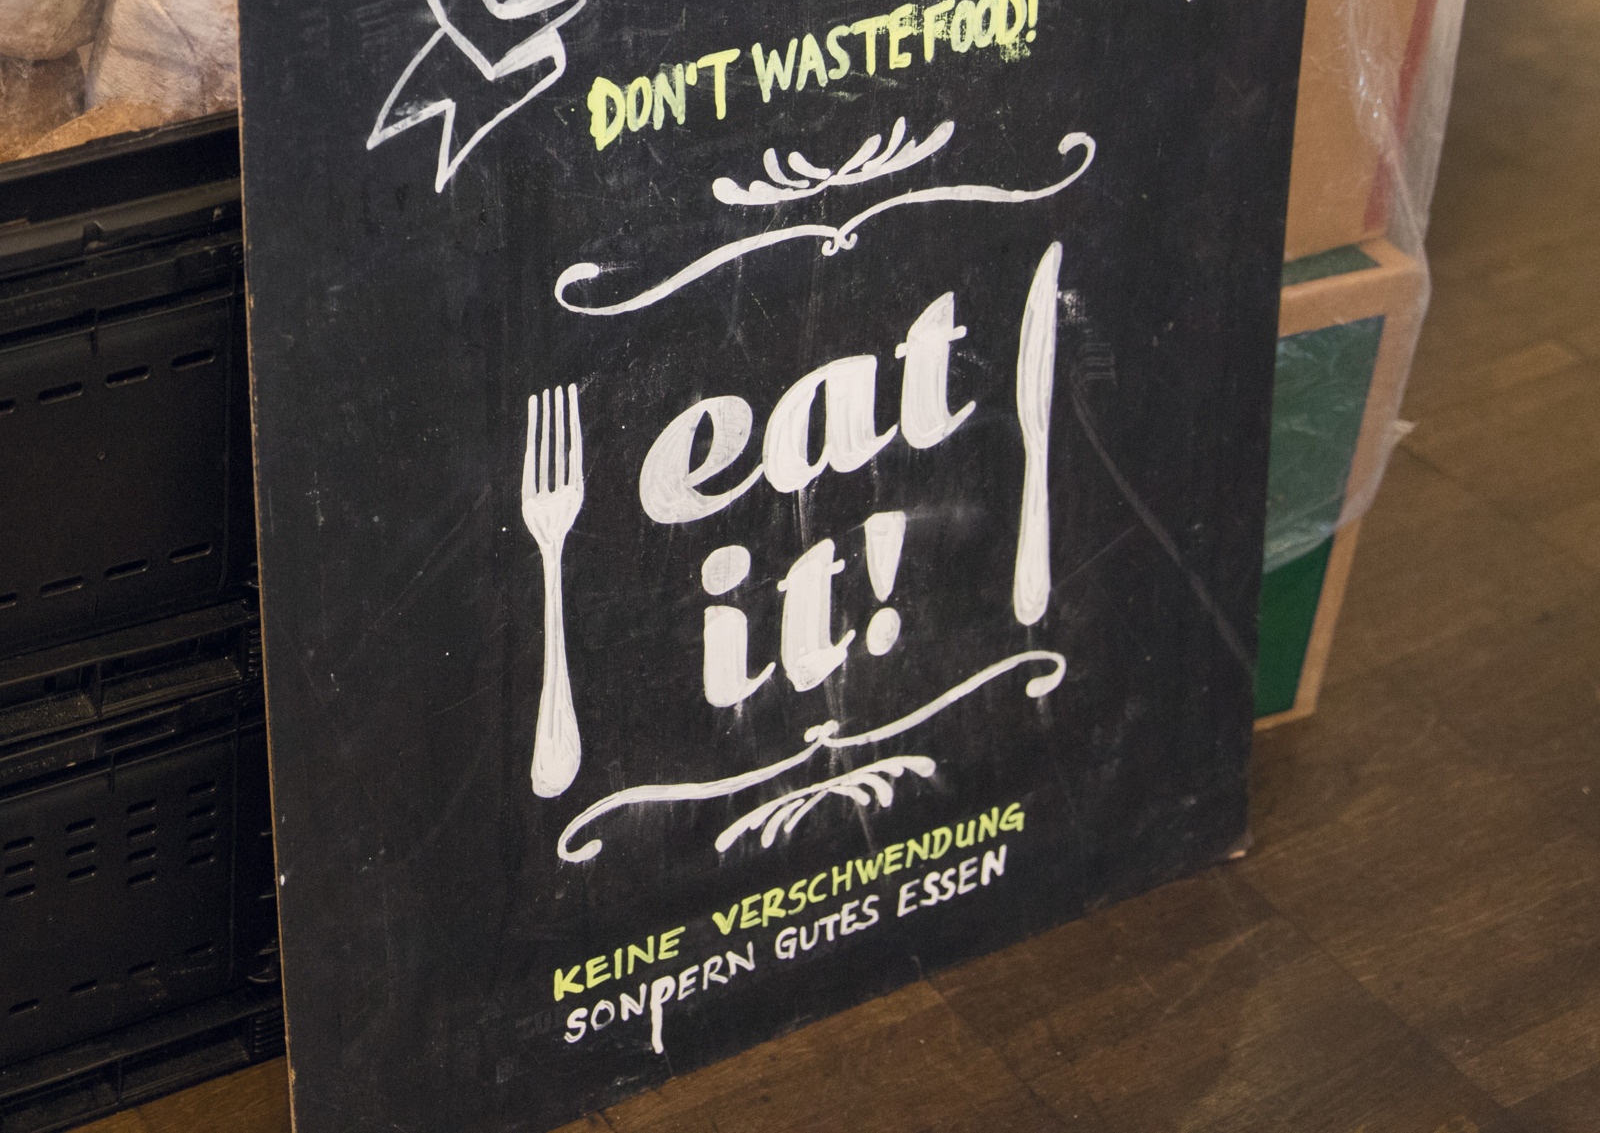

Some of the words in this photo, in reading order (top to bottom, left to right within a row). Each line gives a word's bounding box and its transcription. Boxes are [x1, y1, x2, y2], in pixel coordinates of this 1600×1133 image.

[586, 47, 741, 151] DON'T
[751, 3, 916, 103] WASTE
[639, 290, 977, 524] eat
[701, 510, 907, 708] it!
[553, 925, 687, 1001] KEINE
[711, 802, 1026, 936] VERSCHWENDUNG
[774, 894, 881, 960] GUTES
[896, 844, 1008, 918] ESSEN
